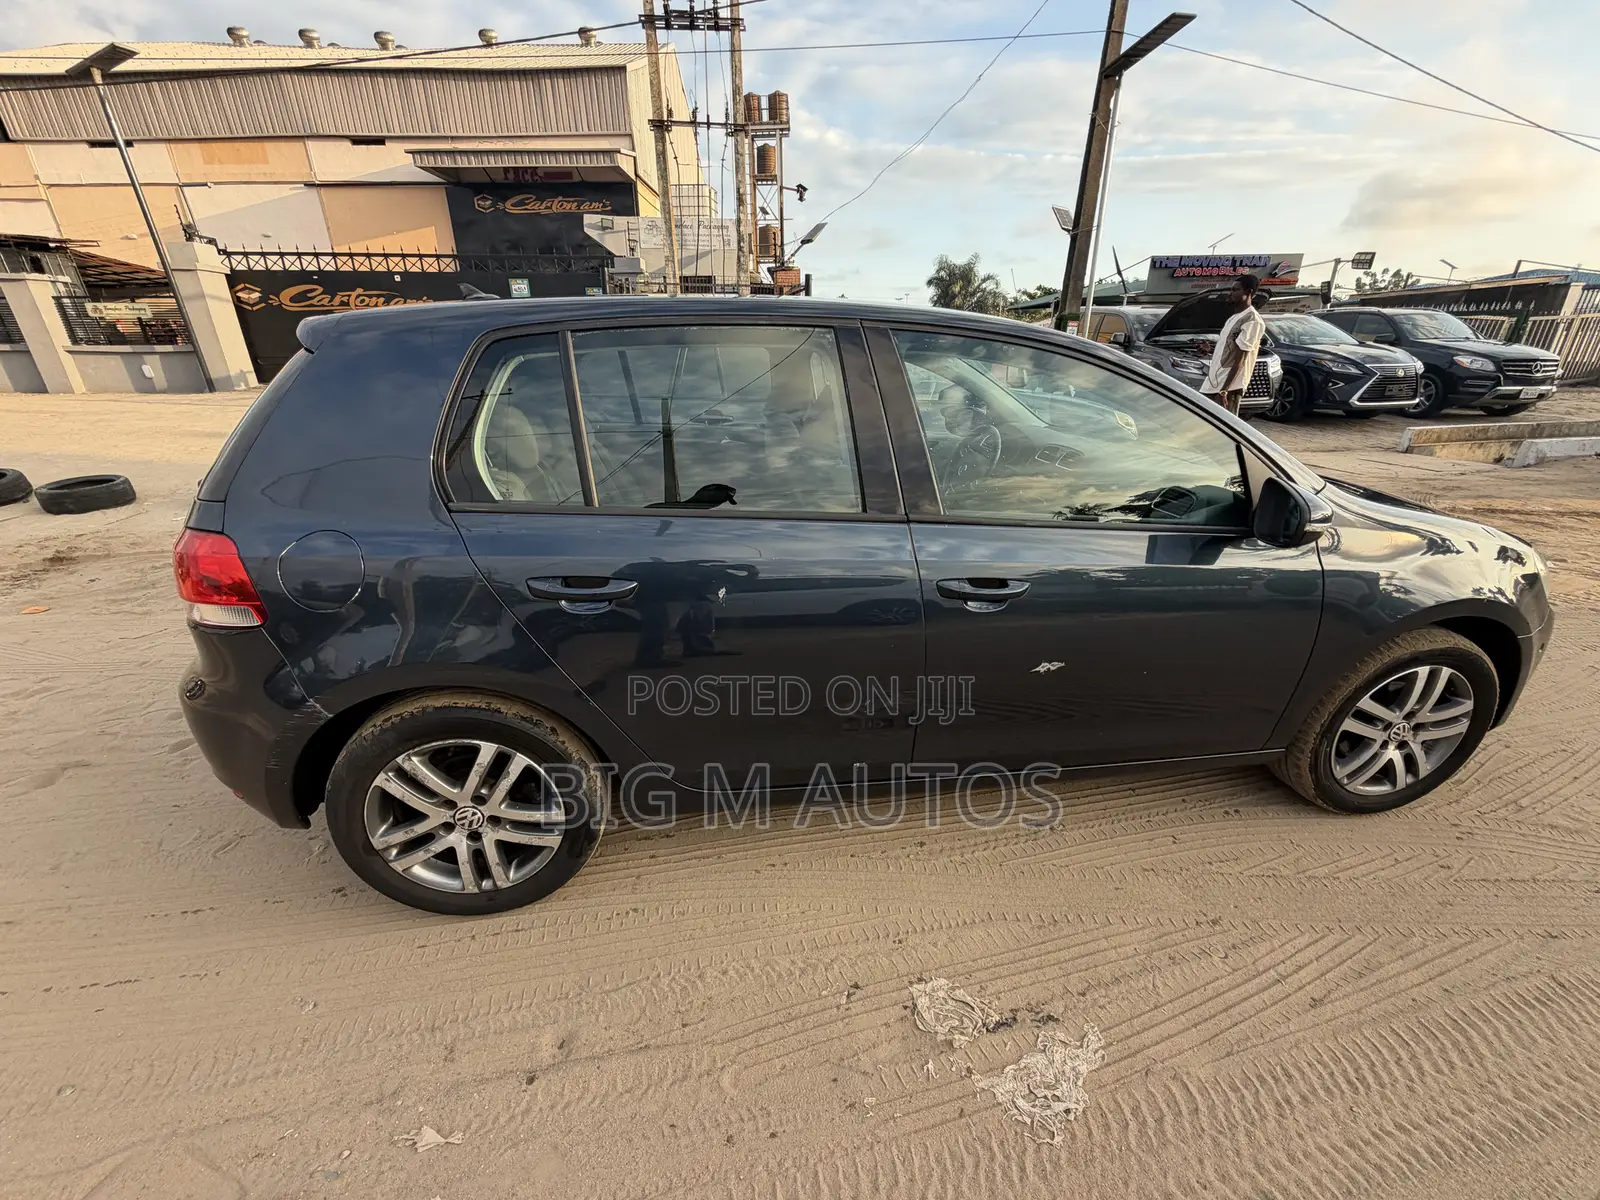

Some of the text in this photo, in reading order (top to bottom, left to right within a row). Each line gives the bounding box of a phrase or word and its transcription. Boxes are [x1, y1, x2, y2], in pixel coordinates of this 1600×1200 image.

[504, 194, 579, 214] Carton
[1153, 255, 1272, 268] THE MOVING TRAIN
[1174, 266, 1250, 277] AUTOMOBILES
[279, 284, 388, 311] Carton
